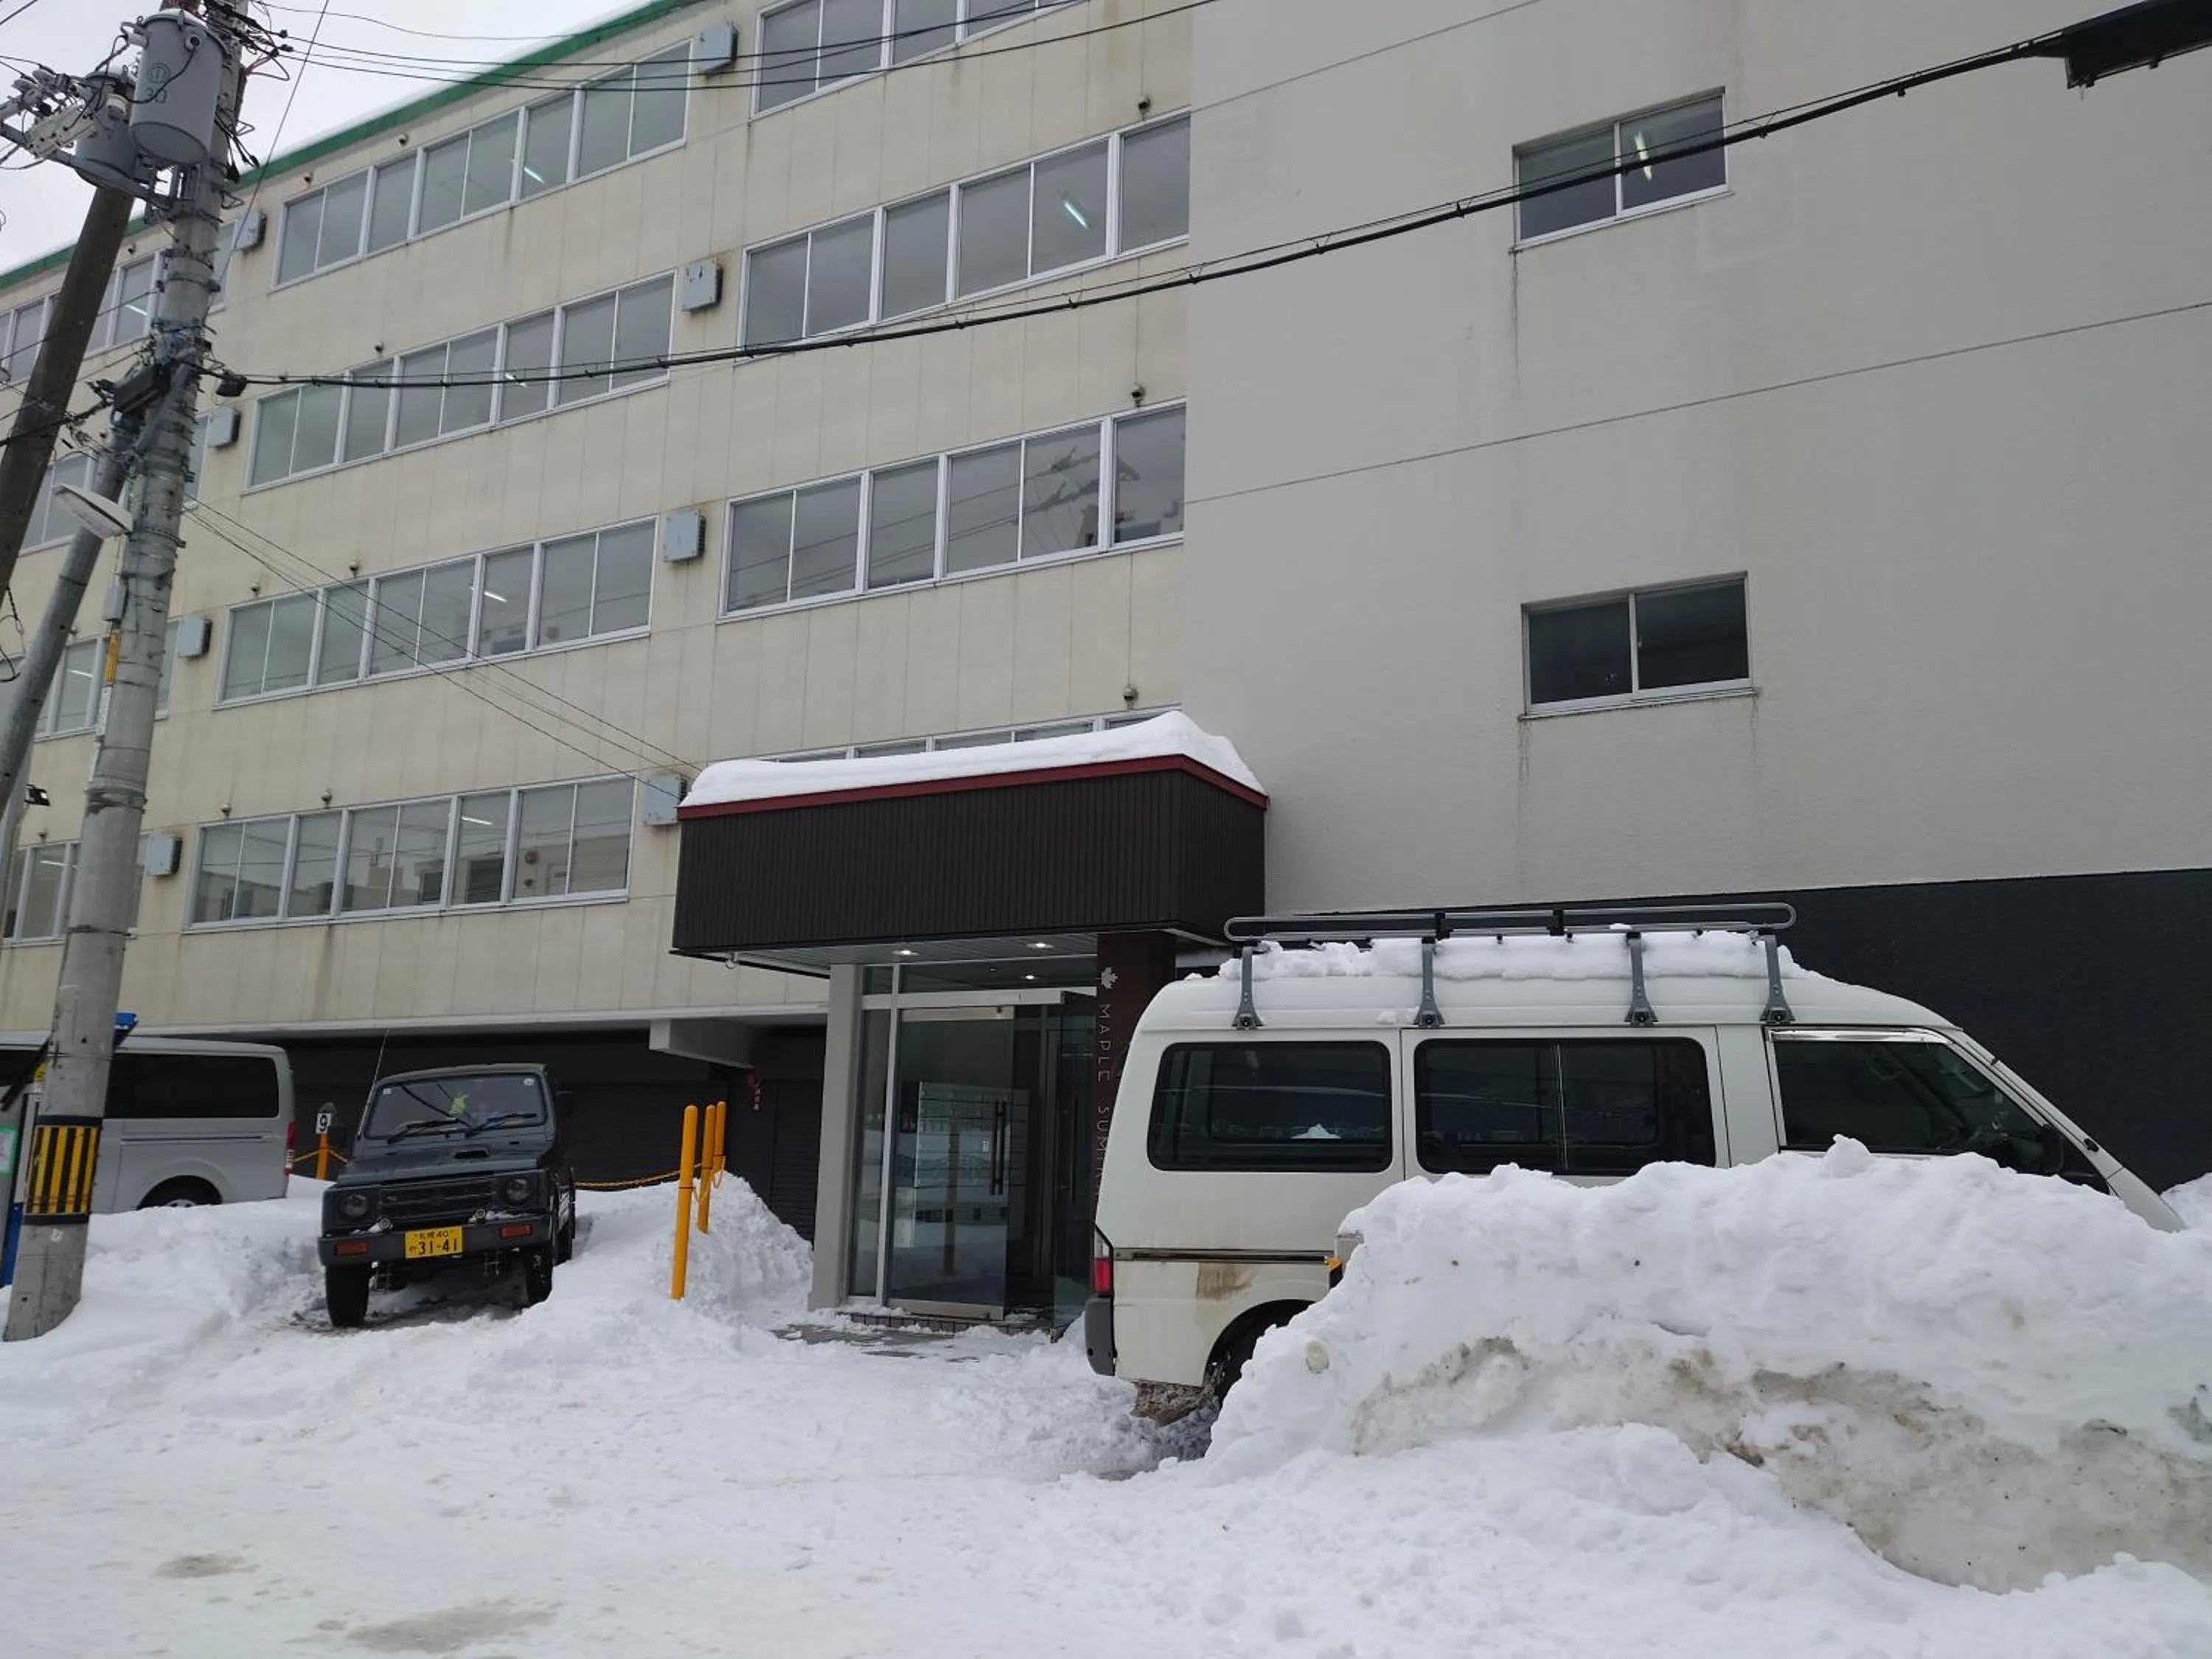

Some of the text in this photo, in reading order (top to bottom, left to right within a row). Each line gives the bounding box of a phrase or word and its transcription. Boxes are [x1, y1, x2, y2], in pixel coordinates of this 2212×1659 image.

[1098, 1003, 1111, 1082] MAPLE
[1096, 1105, 1110, 1194] SUMI
[418, 1238, 456, 1256] 31-41
